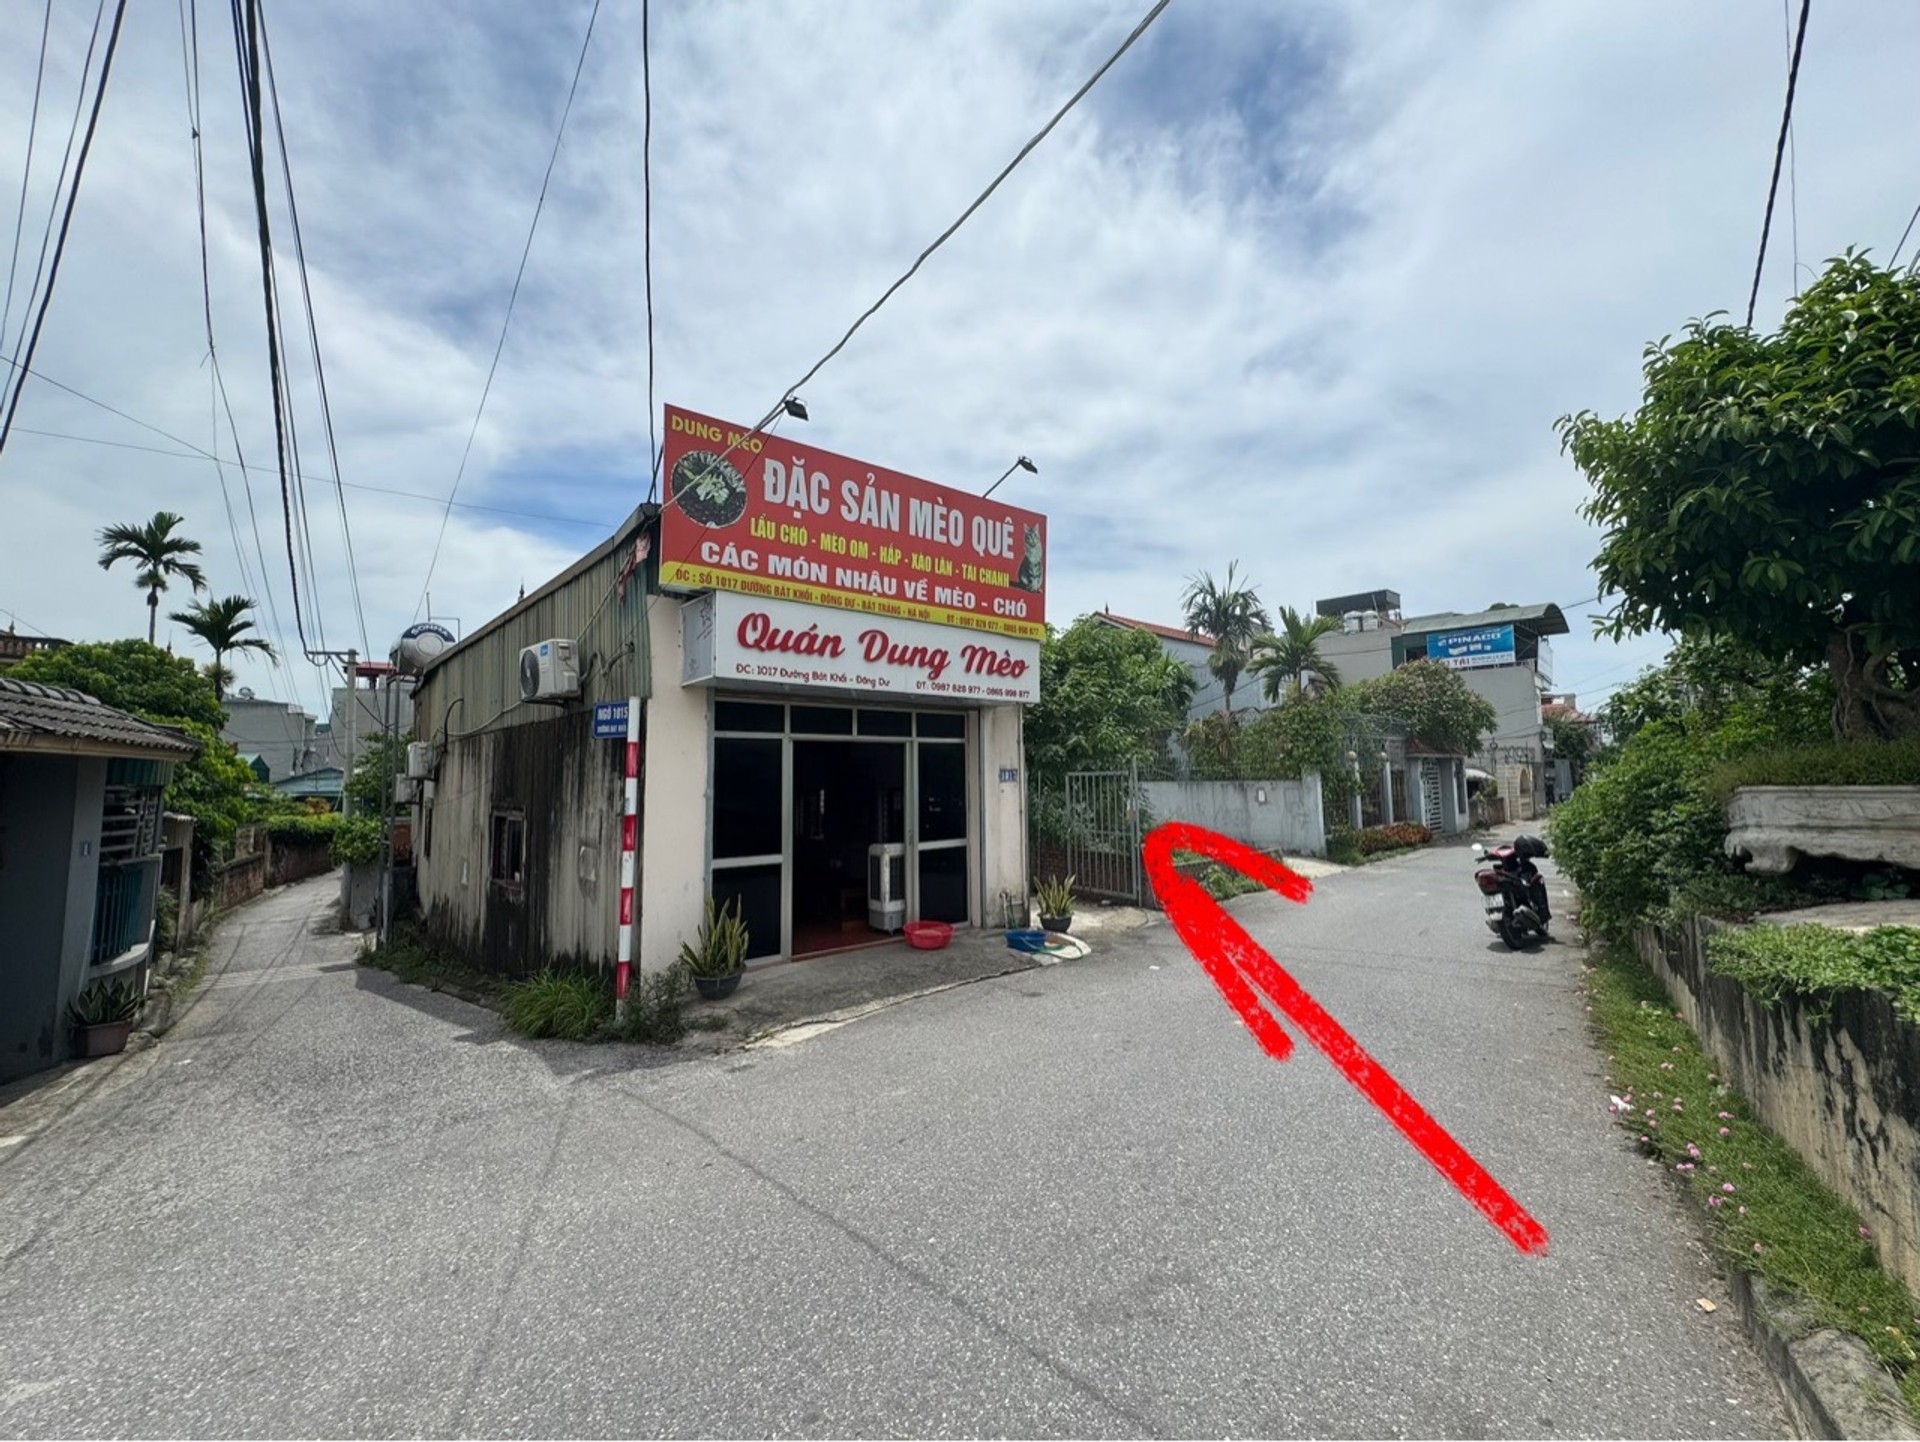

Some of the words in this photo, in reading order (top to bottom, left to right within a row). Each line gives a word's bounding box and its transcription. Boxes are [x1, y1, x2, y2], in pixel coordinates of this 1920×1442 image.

[671, 415, 722, 442] DUNG
[763, 456, 830, 519] ĐẶC
[840, 472, 900, 532] SẢN
[909, 497, 964, 547] MÈO
[972, 516, 1014, 559] QUÊ
[780, 526, 808, 547] CHÓ
[820, 532, 846, 555] MÈO
[850, 540, 869, 559] OM
[979, 568, 1010, 588] CHANH
[699, 571, 712, 584] SỐ
[715, 575, 738, 589] 1017
[701, 541, 759, 571] CÁC
[768, 556, 827, 584] MÓN
[835, 567, 897, 597] NHẬU
[934, 586, 977, 610] MÈO
[993, 598, 1027, 618] CHÓ
[736, 612, 846, 658] Quán
[858, 629, 952, 681] Dung
[960, 643, 1030, 679] Mèo
[1447, 632, 1501, 646] PINACO
[757, 665, 778, 677] 1017
